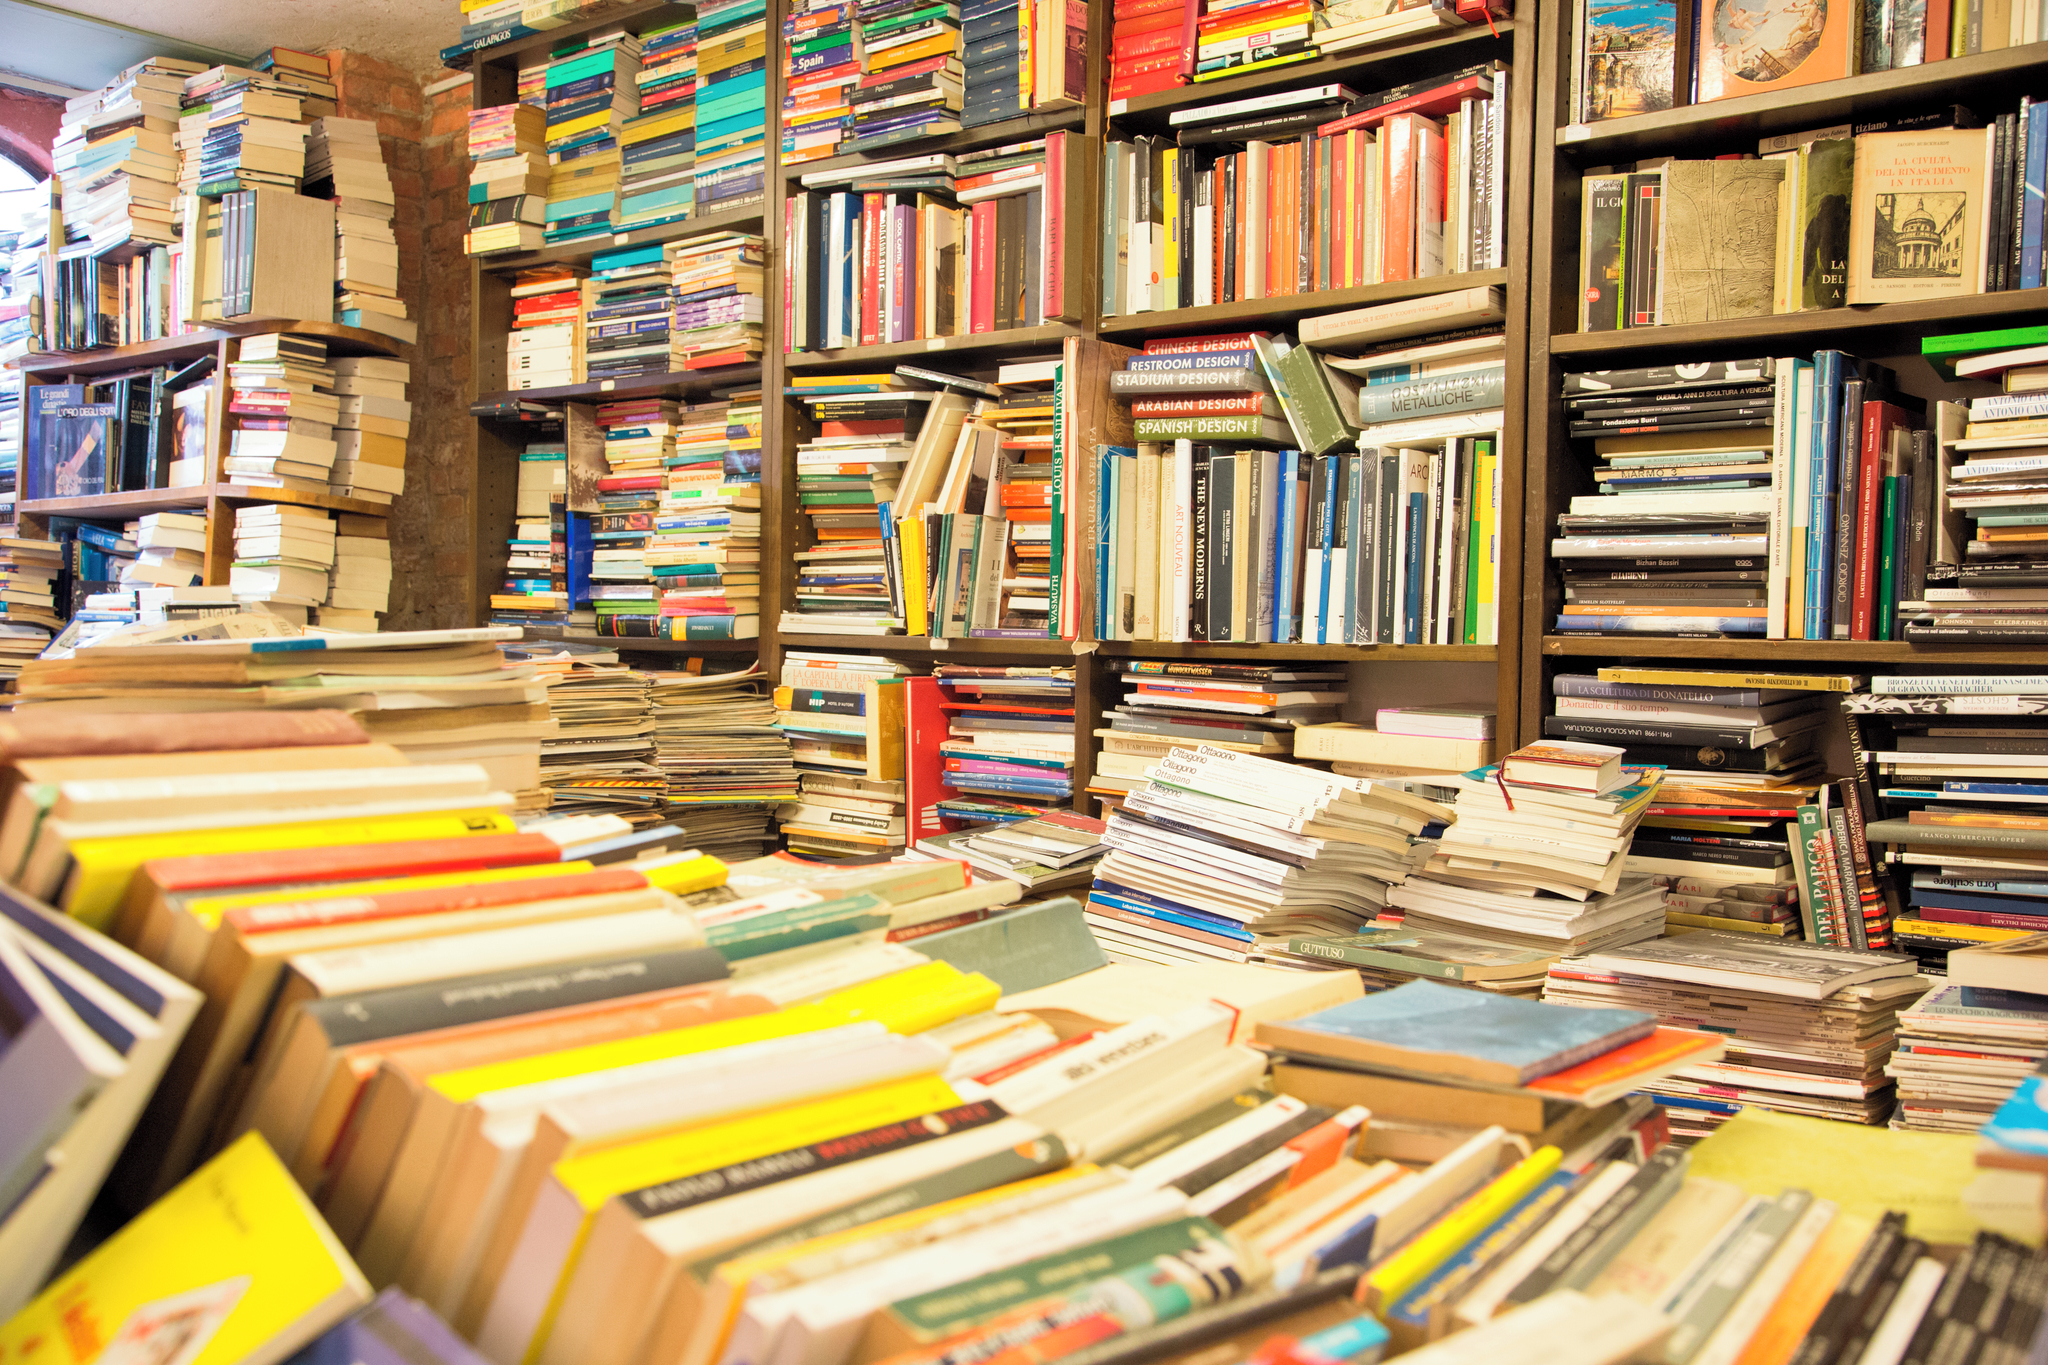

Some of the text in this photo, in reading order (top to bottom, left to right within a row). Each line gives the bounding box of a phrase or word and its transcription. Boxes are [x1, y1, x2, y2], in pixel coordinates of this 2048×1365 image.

[796, 18, 816, 29] Scozia
[473, 29, 511, 50] GALAPAGOS
[792, 44, 806, 54] Nepal
[798, 55, 823, 71] Spain
[875, 84, 893, 93] Pechino
[796, 93, 820, 104] Argentina
[1855, 120, 1888, 133] tiziano
[1895, 155, 1952, 165] LA CIVILTÀ
[1875, 166, 1970, 177] DEL RINASCIMENTO
[1448, 143, 1457, 223] Architettura Romanica
[1891, 177, 1954, 187] IN ITALIA
[1597, 198, 1607, 208] IL
[2016, 195, 2024, 218] PIAZZA
[1831, 260, 1845, 270] LA
[1822, 274, 1844, 284] DEL
[1148, 338, 1250, 355] CHINESE DESIGN
[1131, 356, 1240, 371] RESTROOM DESIGN
[1117, 372, 1230, 386] STADIUM DESIGN
[40, 389, 69, 400] Le grandi
[1656, 392, 1682, 401] DUEMILA
[1706, 389, 1738, 397] SCULTURA
[1746, 386, 1772, 394] VENEZIA
[1137, 399, 1247, 411] ARABIAN DESIGN
[1392, 390, 1473, 413] METALLICHE
[79, 407, 98, 416] DEGLI
[1983, 407, 2025, 419] ANTONIO
[1138, 421, 1247, 434] SPANISH DESIGN
[1603, 418, 1639, 426] Fondazione
[1089, 426, 1097, 491] SVELATA
[1621, 469, 1664, 478] MARMO
[1174, 504, 1184, 577] ART NOUVEAU
[1195, 477, 1205, 600] THE NEW MODERNS
[1839, 514, 1850, 558] ZENNARO
[1636, 559, 1657, 567] Bizhan
[1838, 562, 1848, 603] GIORGIO
[793, 669, 802, 677] LA
[804, 670, 839, 680] CAPITALE
[851, 674, 883, 683] FIRENZE
[1167, 665, 1213, 676] HUNDERTWASSER
[801, 679, 831, 688] L'OPERA
[835, 681, 843, 690] DI
[1578, 686, 1713, 701] LA SCULTURA DI DONATELLO
[809, 699, 825, 707] HIP
[1963, 696, 2010, 704] GHOSTS
[1560, 698, 1669, 715] Donatello e il suo tempo
[1564, 724, 1594, 734] SCULTURA
[1602, 727, 1627, 736] SCUOLA
[1644, 730, 1672, 738] 1941-1998
[1172, 747, 1207, 764] Ottagono
[1162, 758, 1197, 775] Ottagono
[1154, 768, 1191, 785] Ottagono
[1132, 790, 1155, 802] Ottagono
[1150, 782, 1182, 799] Ottagono
[1127, 799, 1150, 811] Ottagono
[1103, 836, 1125, 847] Ottagono
[1834, 814, 1858, 911] FEDERICA MARANGONI
[1933, 877, 2000, 891] Jorn scultore
[1122, 902, 1155, 916] Lotus International
[1300, 942, 1345, 959] GUTTUSO
[1584, 974, 1619, 983] L'architettura
[1947, 1008, 1985, 1017] SPECCHIO
[1987, 1008, 2019, 1018] MAGICO
